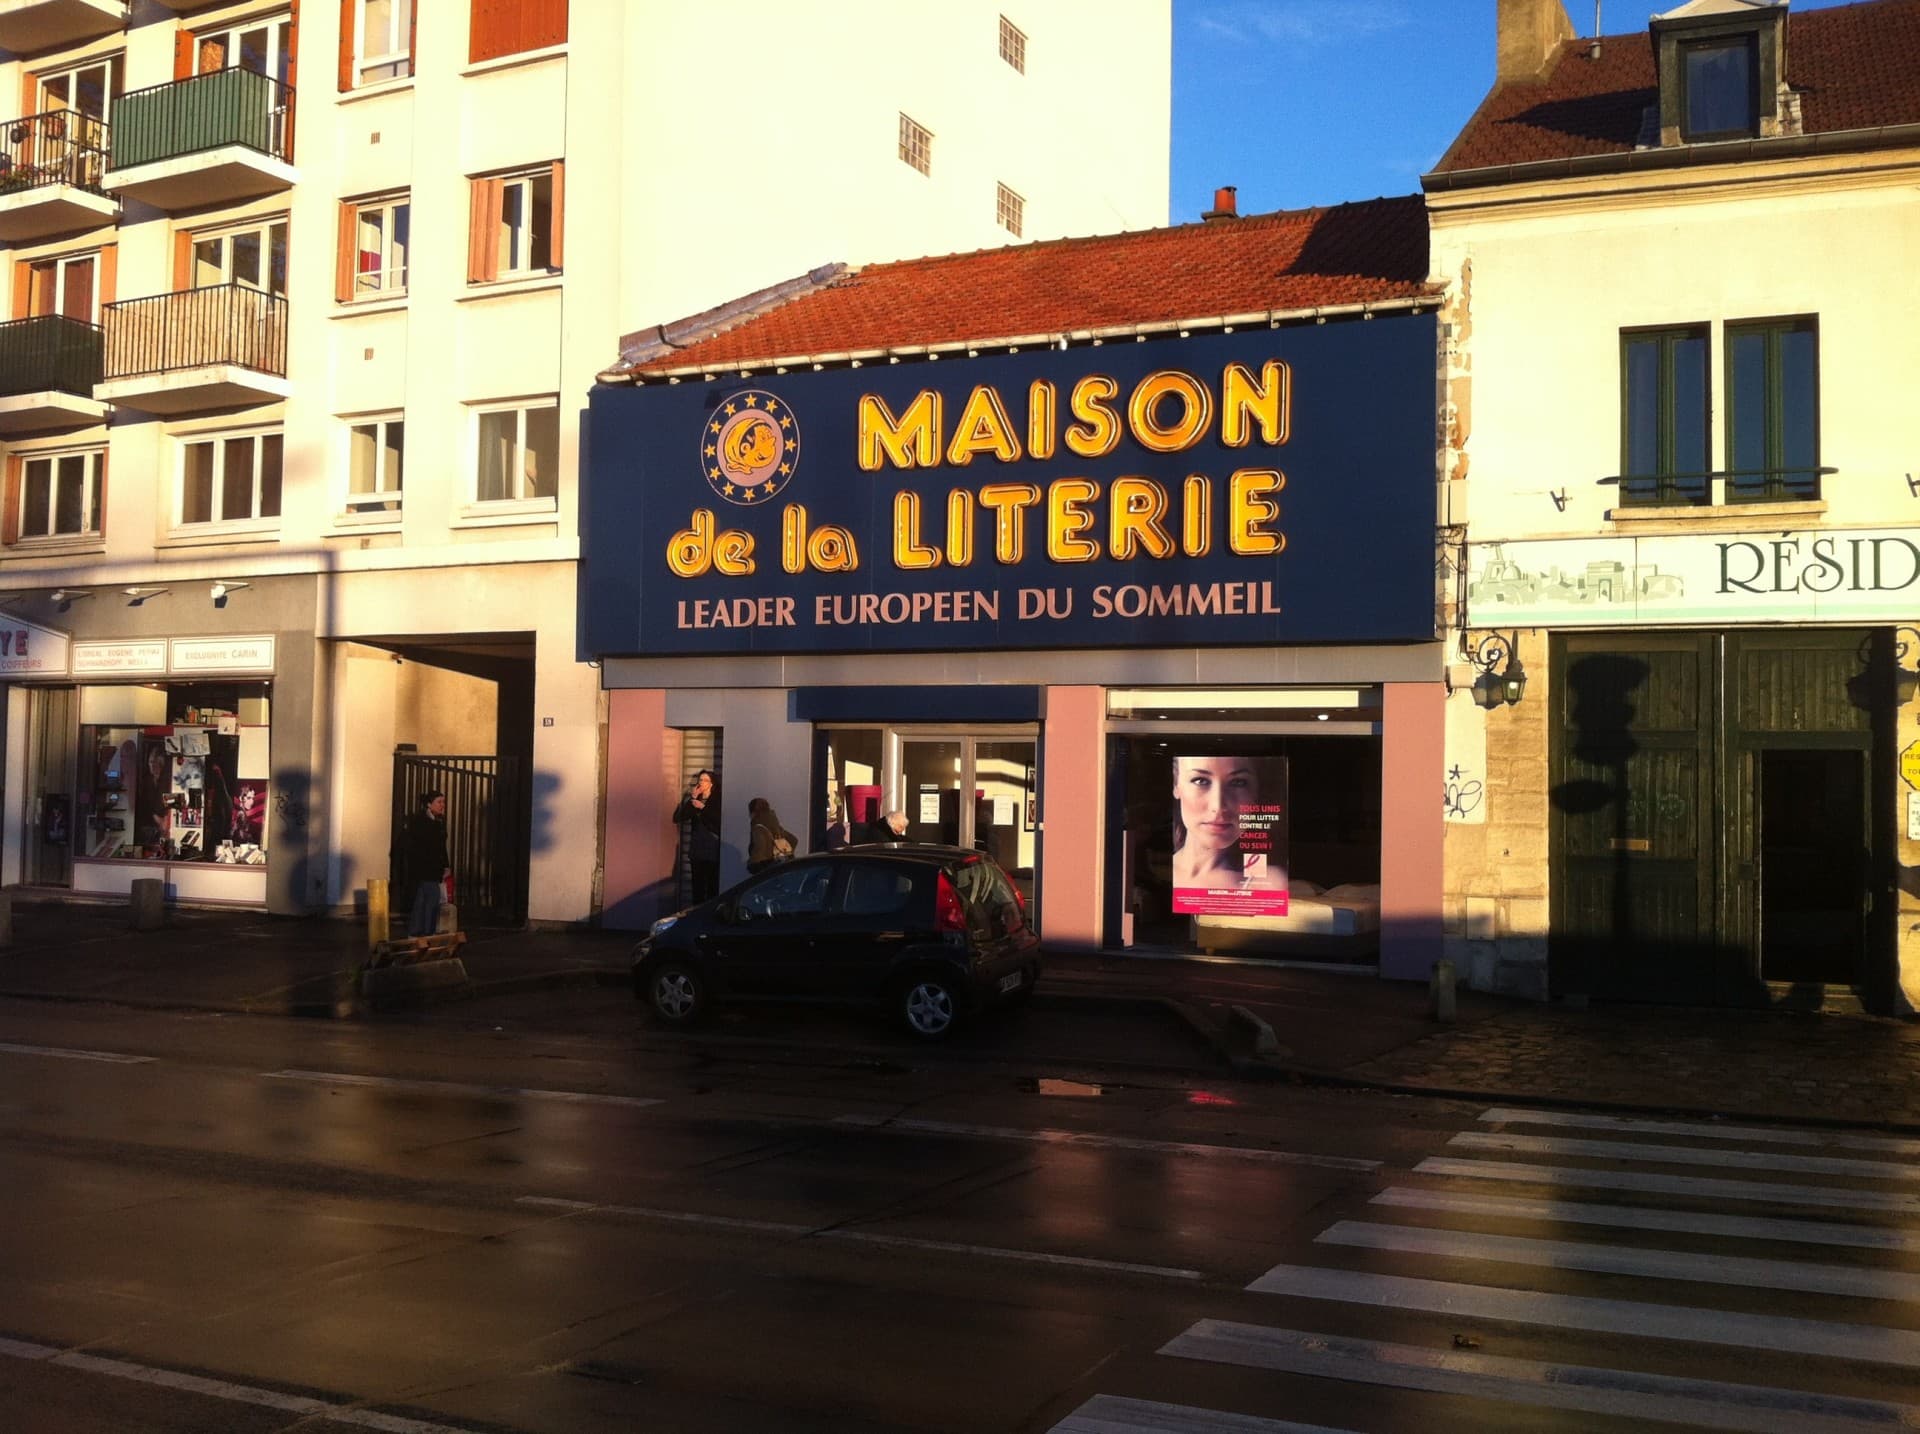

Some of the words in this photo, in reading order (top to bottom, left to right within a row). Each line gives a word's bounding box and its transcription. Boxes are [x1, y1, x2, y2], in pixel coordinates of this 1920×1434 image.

[858, 358, 1291, 472] MAISON
[666, 507, 757, 578] de
[781, 503, 859, 574] la
[892, 468, 1287, 570] LITERIE
[1714, 531, 1920, 595] RÉSID
[677, 597, 797, 629] LEADER
[814, 590, 999, 625] EUROPEEN
[1018, 587, 1073, 620] DU
[1091, 581, 1281, 618] SOMMEIL
